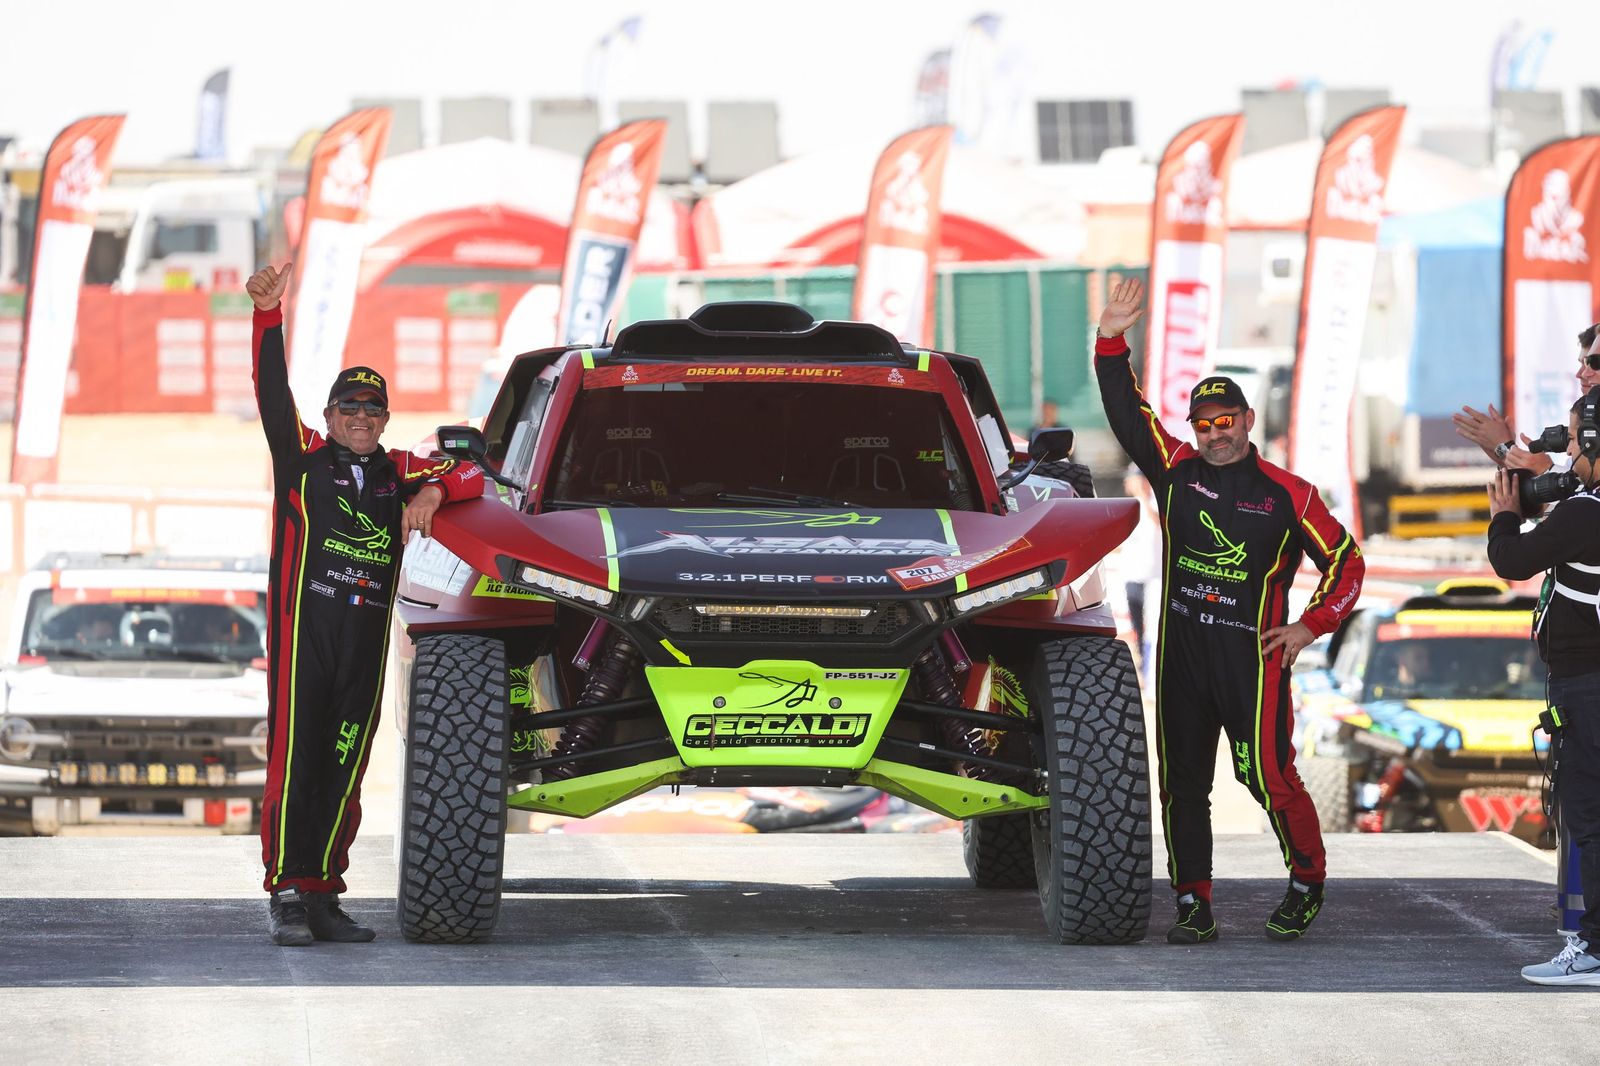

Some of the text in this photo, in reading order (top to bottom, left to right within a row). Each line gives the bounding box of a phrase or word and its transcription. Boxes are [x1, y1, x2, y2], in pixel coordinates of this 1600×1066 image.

[686, 367, 843, 377] DREAM. DARE. LIVE IT.
[347, 371, 381, 386] JLC
[1194, 382, 1226, 399] JLC
[906, 567, 933, 577] 207
[1178, 555, 1248, 581] CECCALDI
[679, 572, 736, 582] 3.2.1
[486, 582, 503, 593] JLC
[1196, 583, 1220, 595] 3.2.1
[825, 672, 897, 680] FP-551-JZ
[686, 714, 867, 737] CECCALDI
[755, 736, 810, 745] clothes
[818, 737, 851, 745] wear
